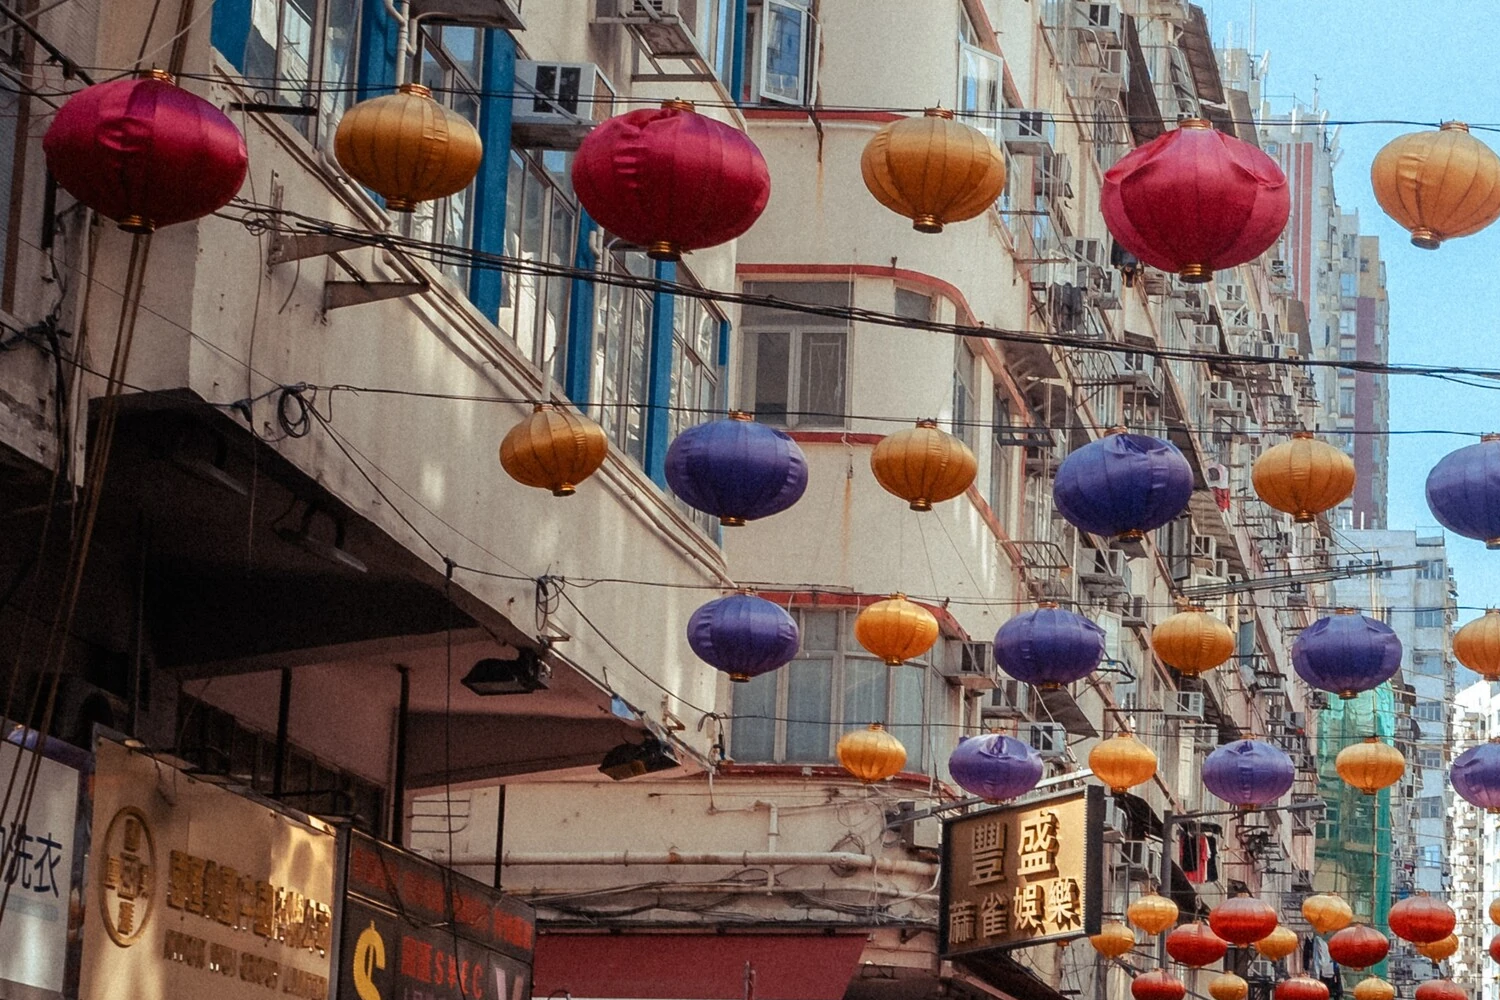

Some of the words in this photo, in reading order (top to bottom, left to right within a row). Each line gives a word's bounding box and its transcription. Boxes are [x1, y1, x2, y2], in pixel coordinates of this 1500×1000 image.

[0, 823, 63, 898] 洗衣
[968, 811, 1060, 887] 豐盛
[948, 878, 1078, 944] 麻雀娛樂
